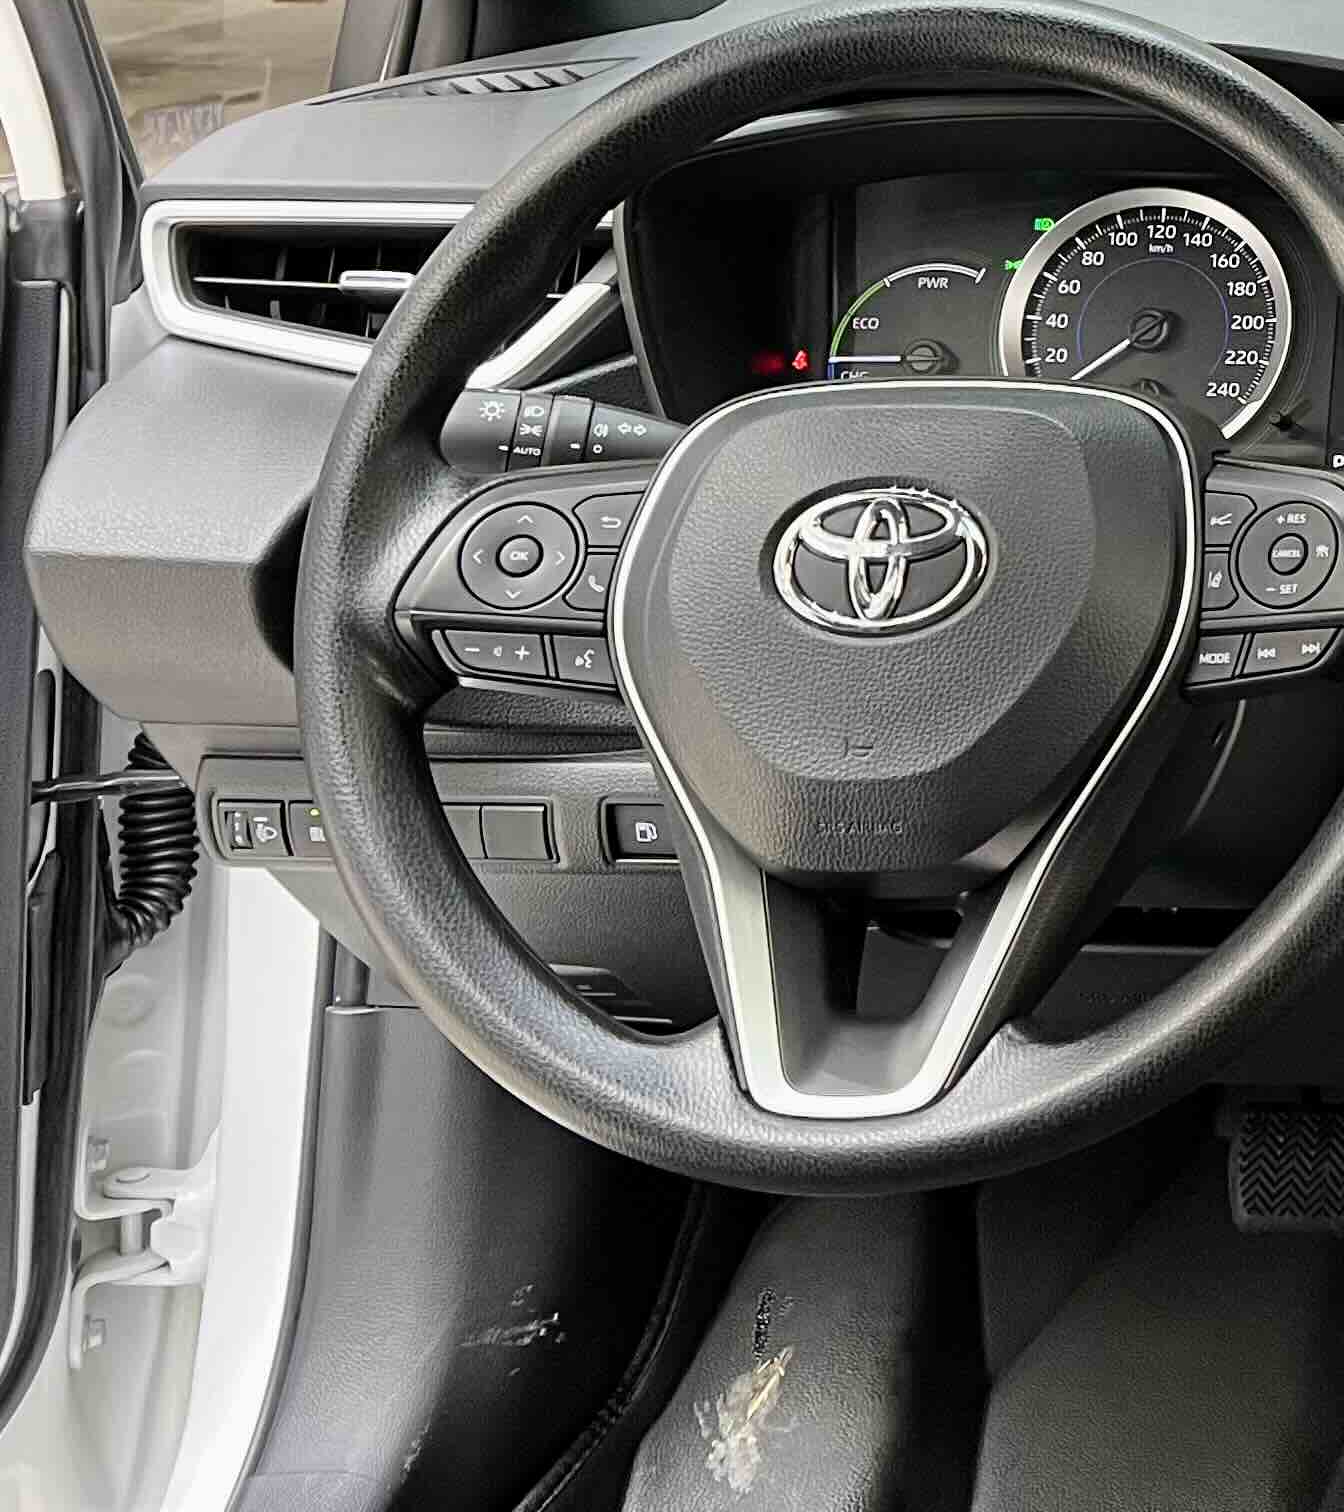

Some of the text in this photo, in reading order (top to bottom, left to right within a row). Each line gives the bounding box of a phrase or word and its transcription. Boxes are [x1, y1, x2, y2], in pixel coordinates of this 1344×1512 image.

[1108, 231, 1139, 248] 100
[1147, 224, 1177, 240] 120
[1183, 232, 1213, 248] 140
[1081, 251, 1105, 267] 80
[1210, 253, 1241, 269] 160
[917, 277, 949, 289] PWR
[1058, 279, 1081, 295] 60
[1227, 281, 1257, 297] 180
[852, 317, 880, 330] ECO
[1045, 313, 1069, 329] 40
[1231, 315, 1265, 331] 200
[1045, 348, 1068, 363] 20
[1224, 350, 1259, 365] 220
[1206, 382, 1241, 398] 240
[513, 445, 542, 457] AUTO
[510, 551, 529, 561] OK
[1199, 651, 1232, 665] MODE
